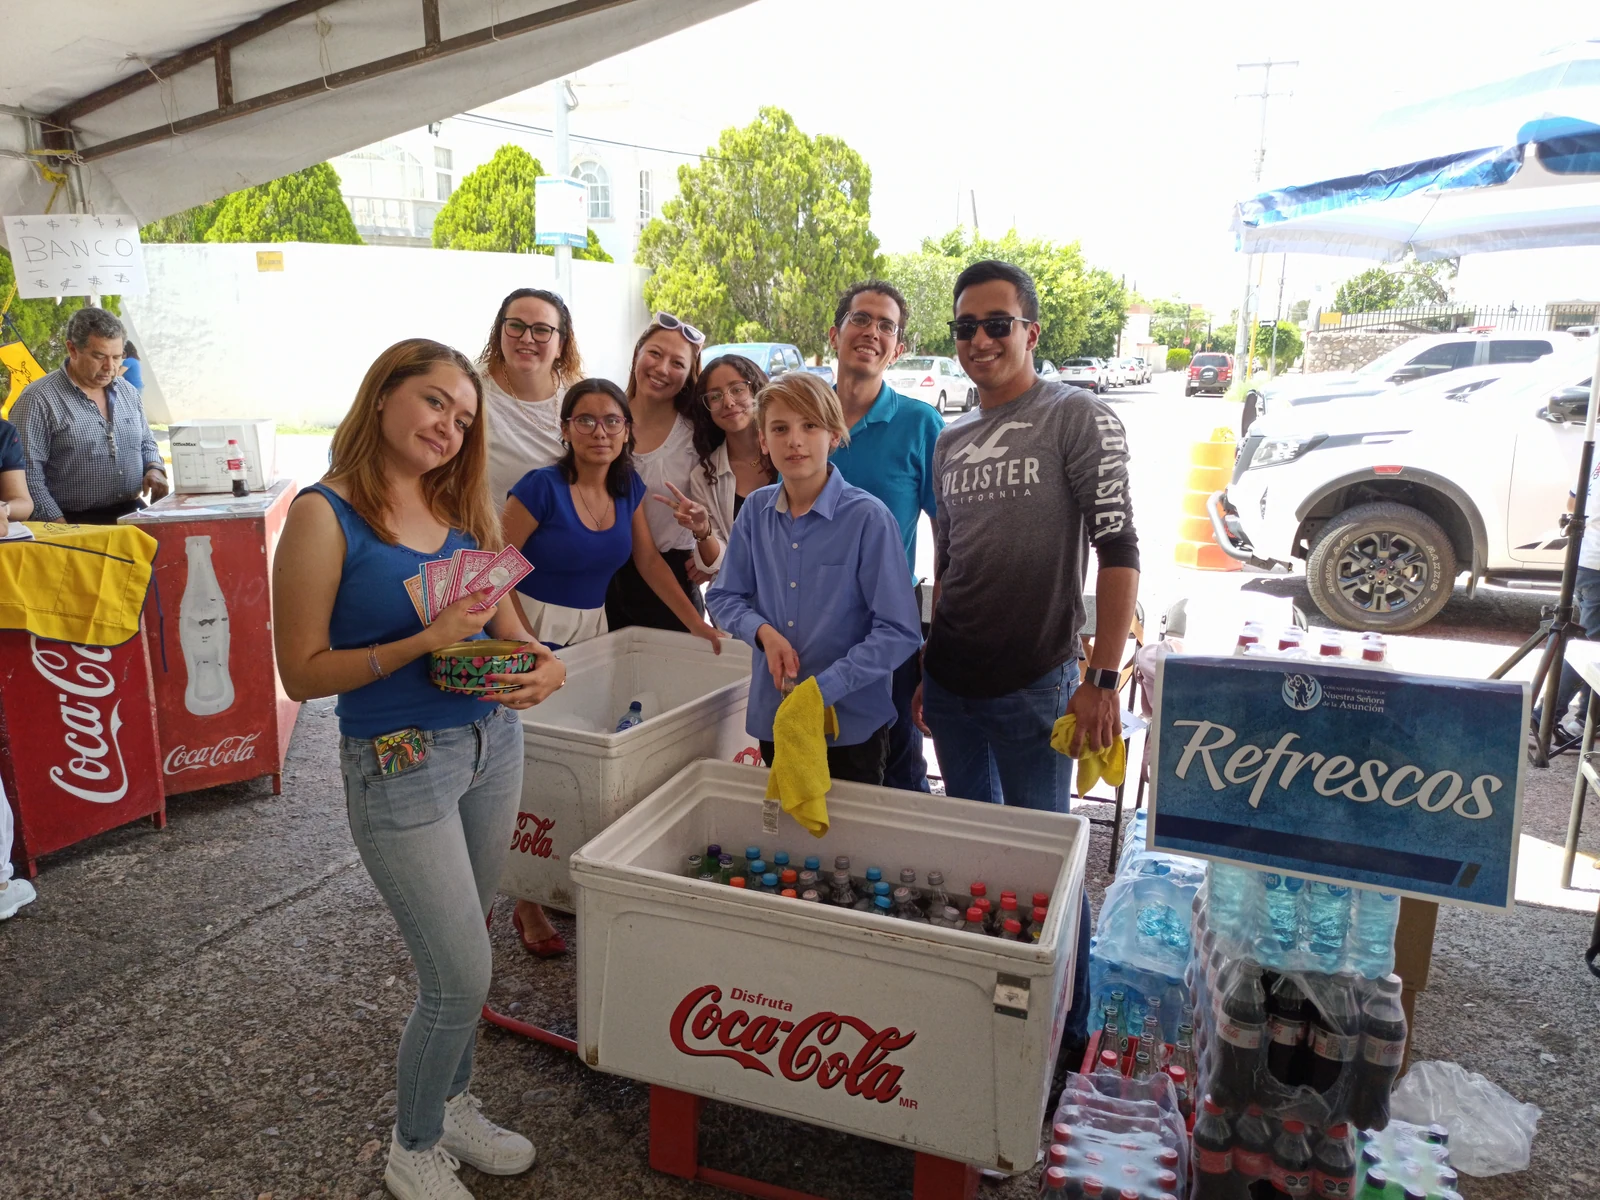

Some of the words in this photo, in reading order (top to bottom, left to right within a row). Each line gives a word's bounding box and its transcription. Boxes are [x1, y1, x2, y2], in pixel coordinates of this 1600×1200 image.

[20, 236, 134, 263] BANCO
[941, 457, 1040, 497] OLLISTER
[1094, 415, 1127, 540] HOLLISTER
[945, 488, 1031, 507] ALIFORNIA
[1425, 545, 1440, 591] MAXXIS
[1322, 690, 1355, 701] Nuestra
[1356, 694, 1385, 705] Señora
[1339, 700, 1385, 713] Asunción
[31, 634, 129, 804] Coca-Co
[163, 731, 262, 775] Coca-Cola
[1173, 719, 1503, 820] Refrescos
[1263, 874, 1278, 886] iel
[730, 987, 793, 1012] Disfruta
[669, 984, 917, 1103] Coca-Cola
[899, 1097, 918, 1110] MR
